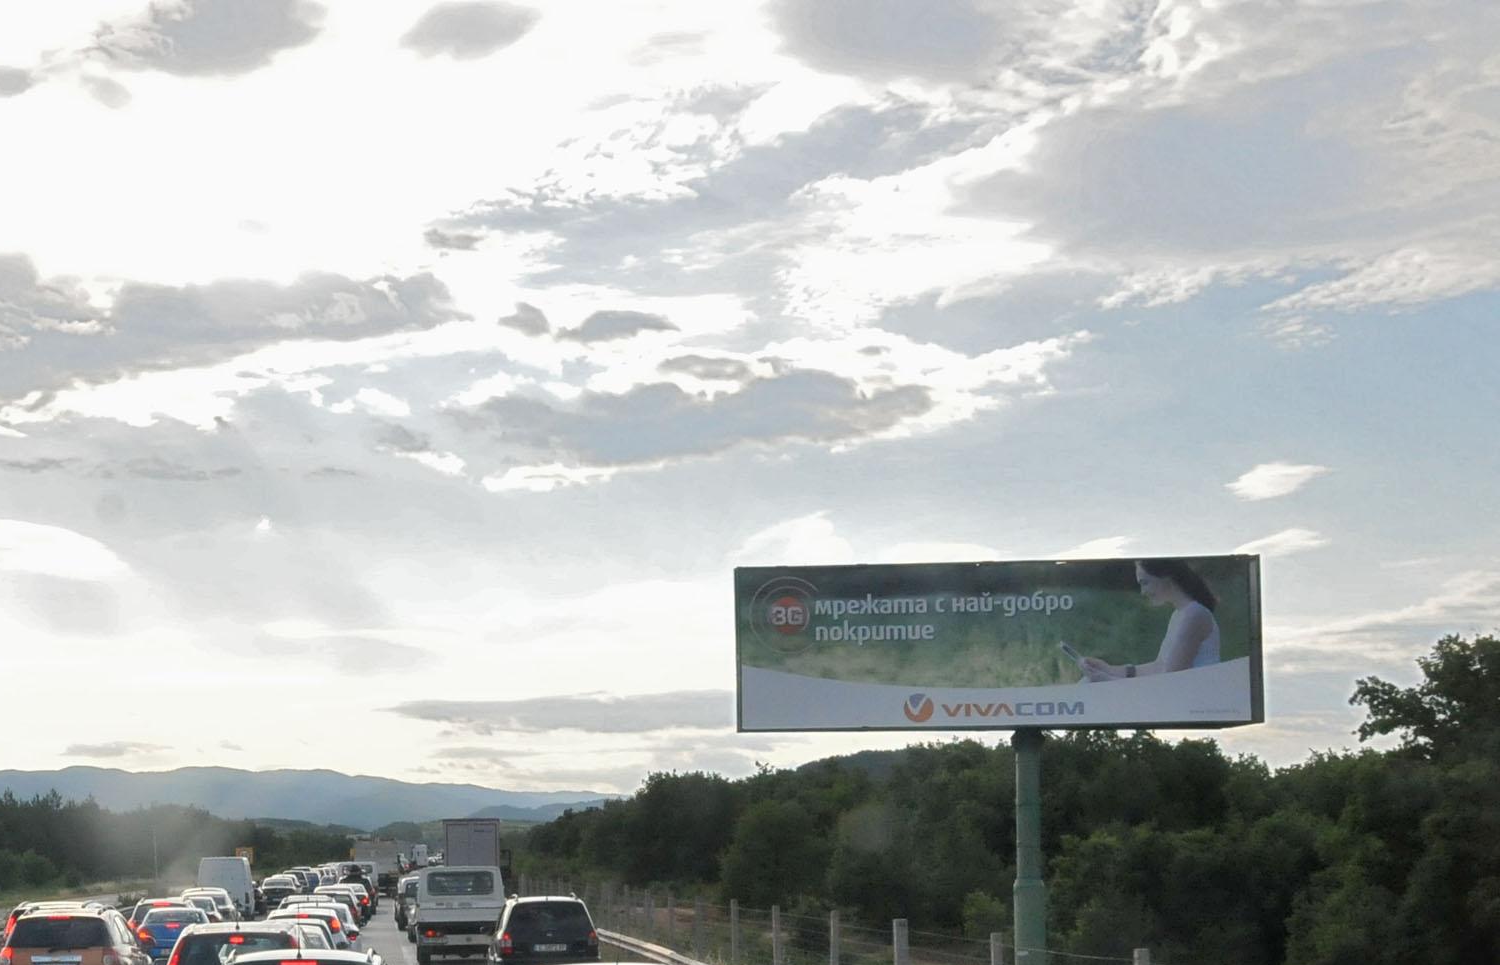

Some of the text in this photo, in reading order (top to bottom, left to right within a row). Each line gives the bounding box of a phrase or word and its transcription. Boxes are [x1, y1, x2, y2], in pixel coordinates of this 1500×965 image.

[771, 606, 804, 625] 3G
[815, 591, 1073, 620] мрежата с най-добро
[815, 620, 934, 645] покритие
[941, 702, 1085, 717] VIVACOM
